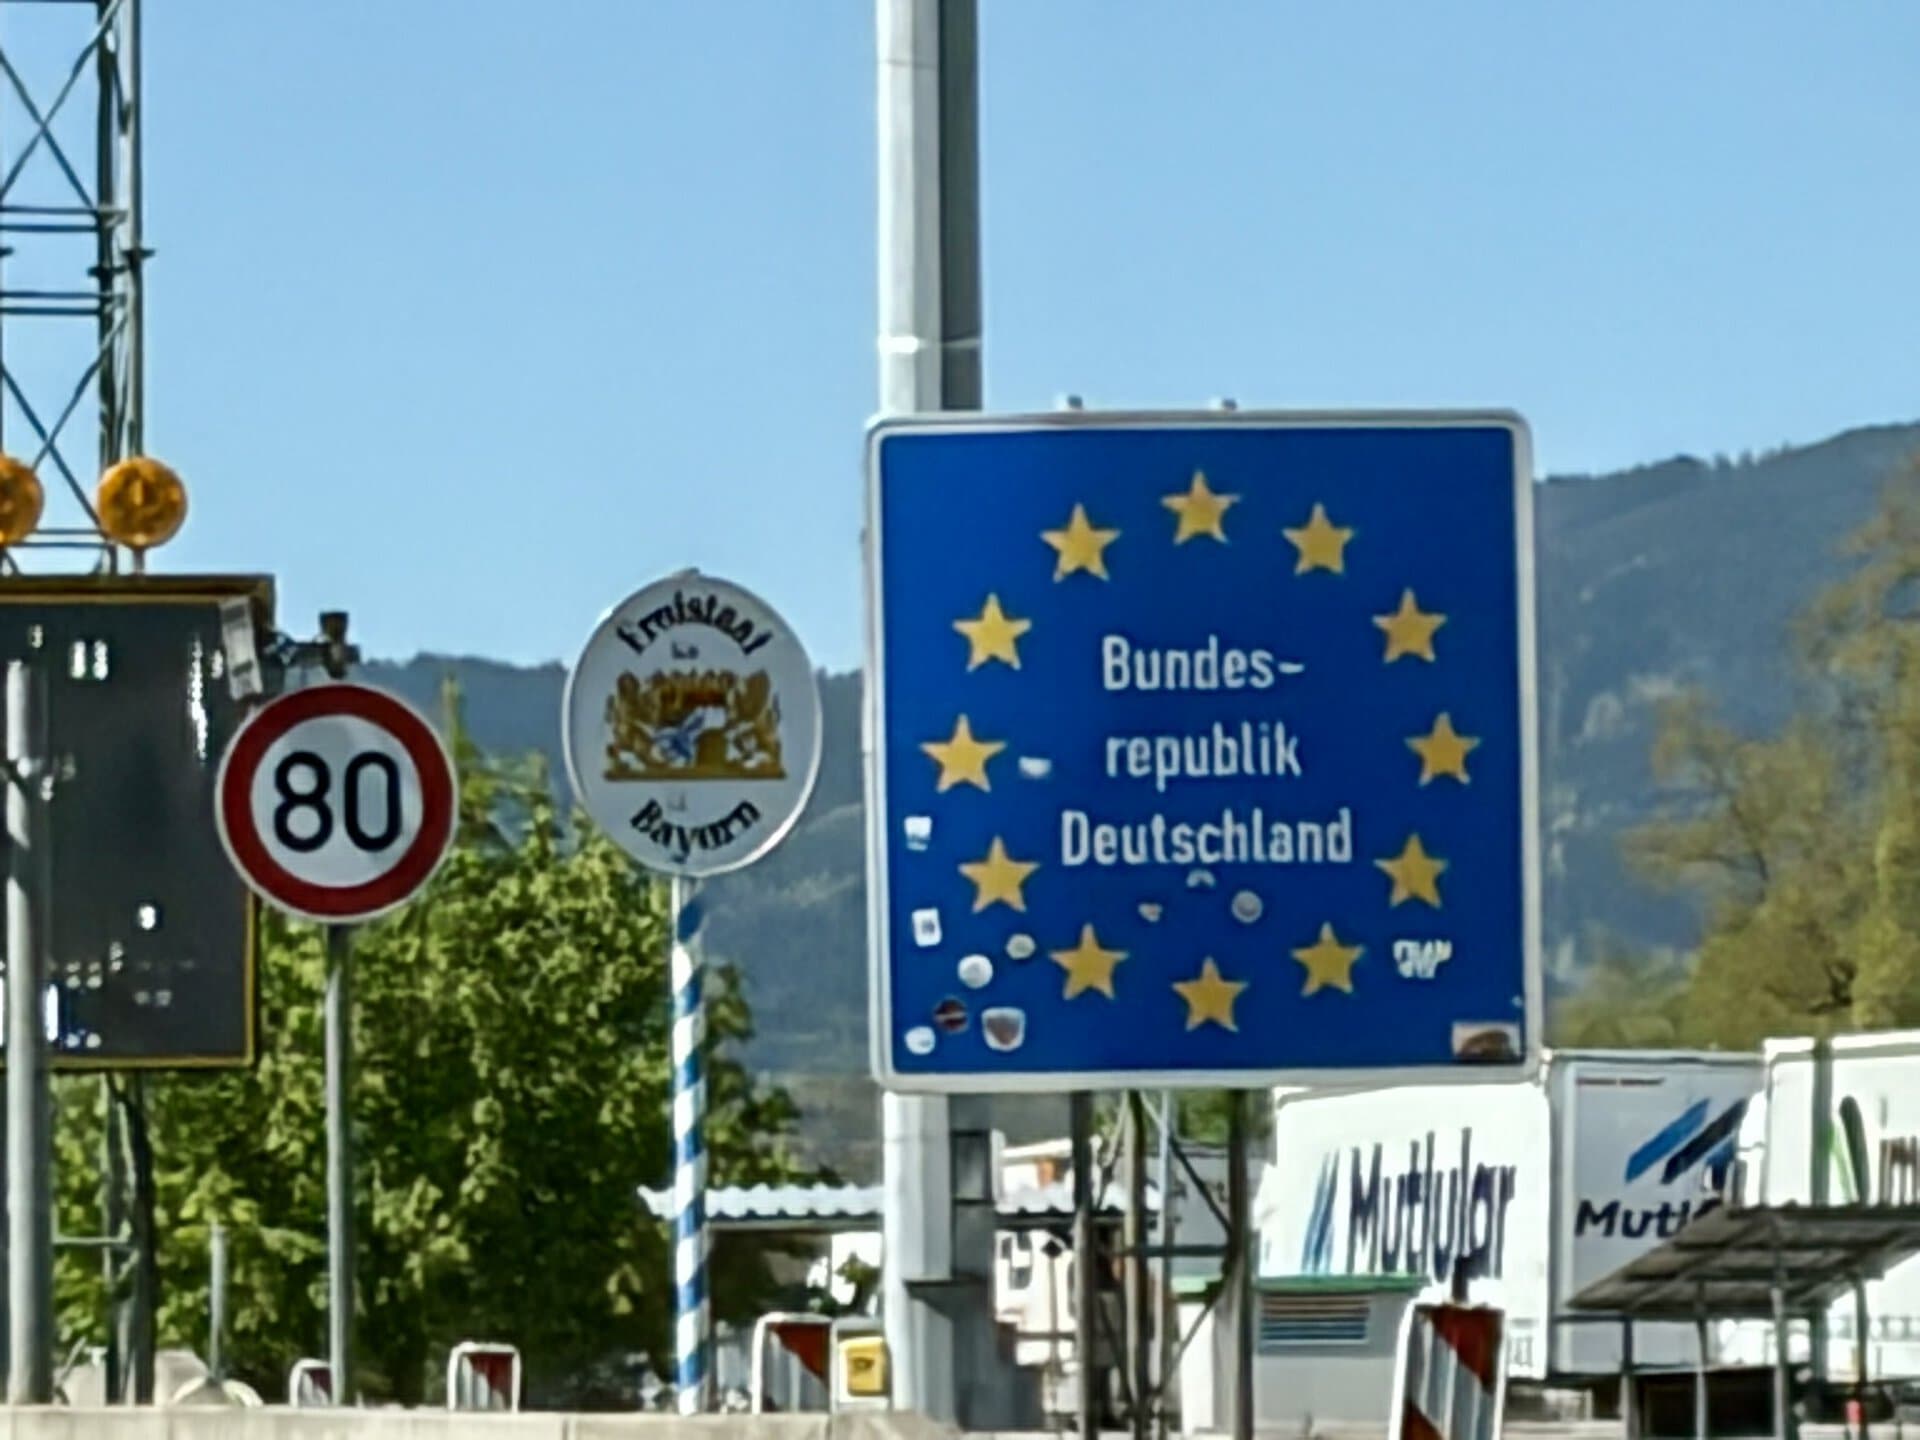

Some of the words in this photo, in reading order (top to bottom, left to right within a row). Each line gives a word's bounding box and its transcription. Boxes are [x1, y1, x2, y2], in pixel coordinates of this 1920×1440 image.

[1102, 634, 1305, 690] Bundes-
[1106, 721, 1302, 793] republik
[273, 751, 401, 852] 80
[1061, 807, 1352, 866] Deutschland
[1574, 1199, 1712, 1238] Mutl
